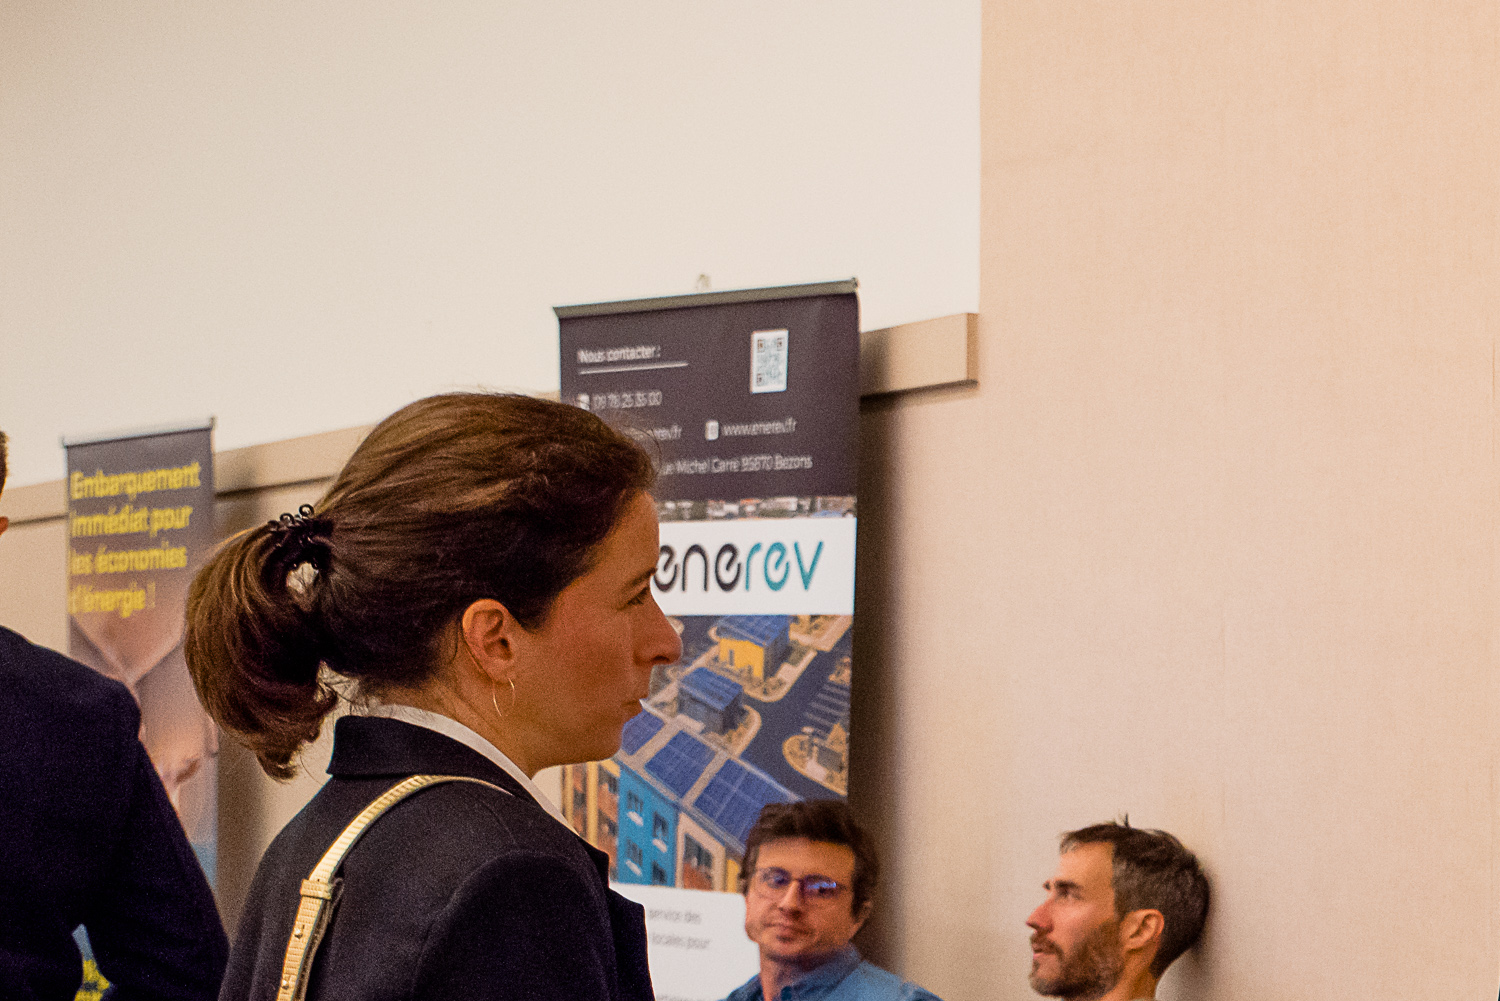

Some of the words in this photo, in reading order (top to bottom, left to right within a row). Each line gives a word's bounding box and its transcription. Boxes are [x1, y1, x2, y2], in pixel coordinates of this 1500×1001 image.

[70, 463, 201, 502] Embarquement
[150, 505, 192, 537] pour
[654, 541, 823, 592] enerev
